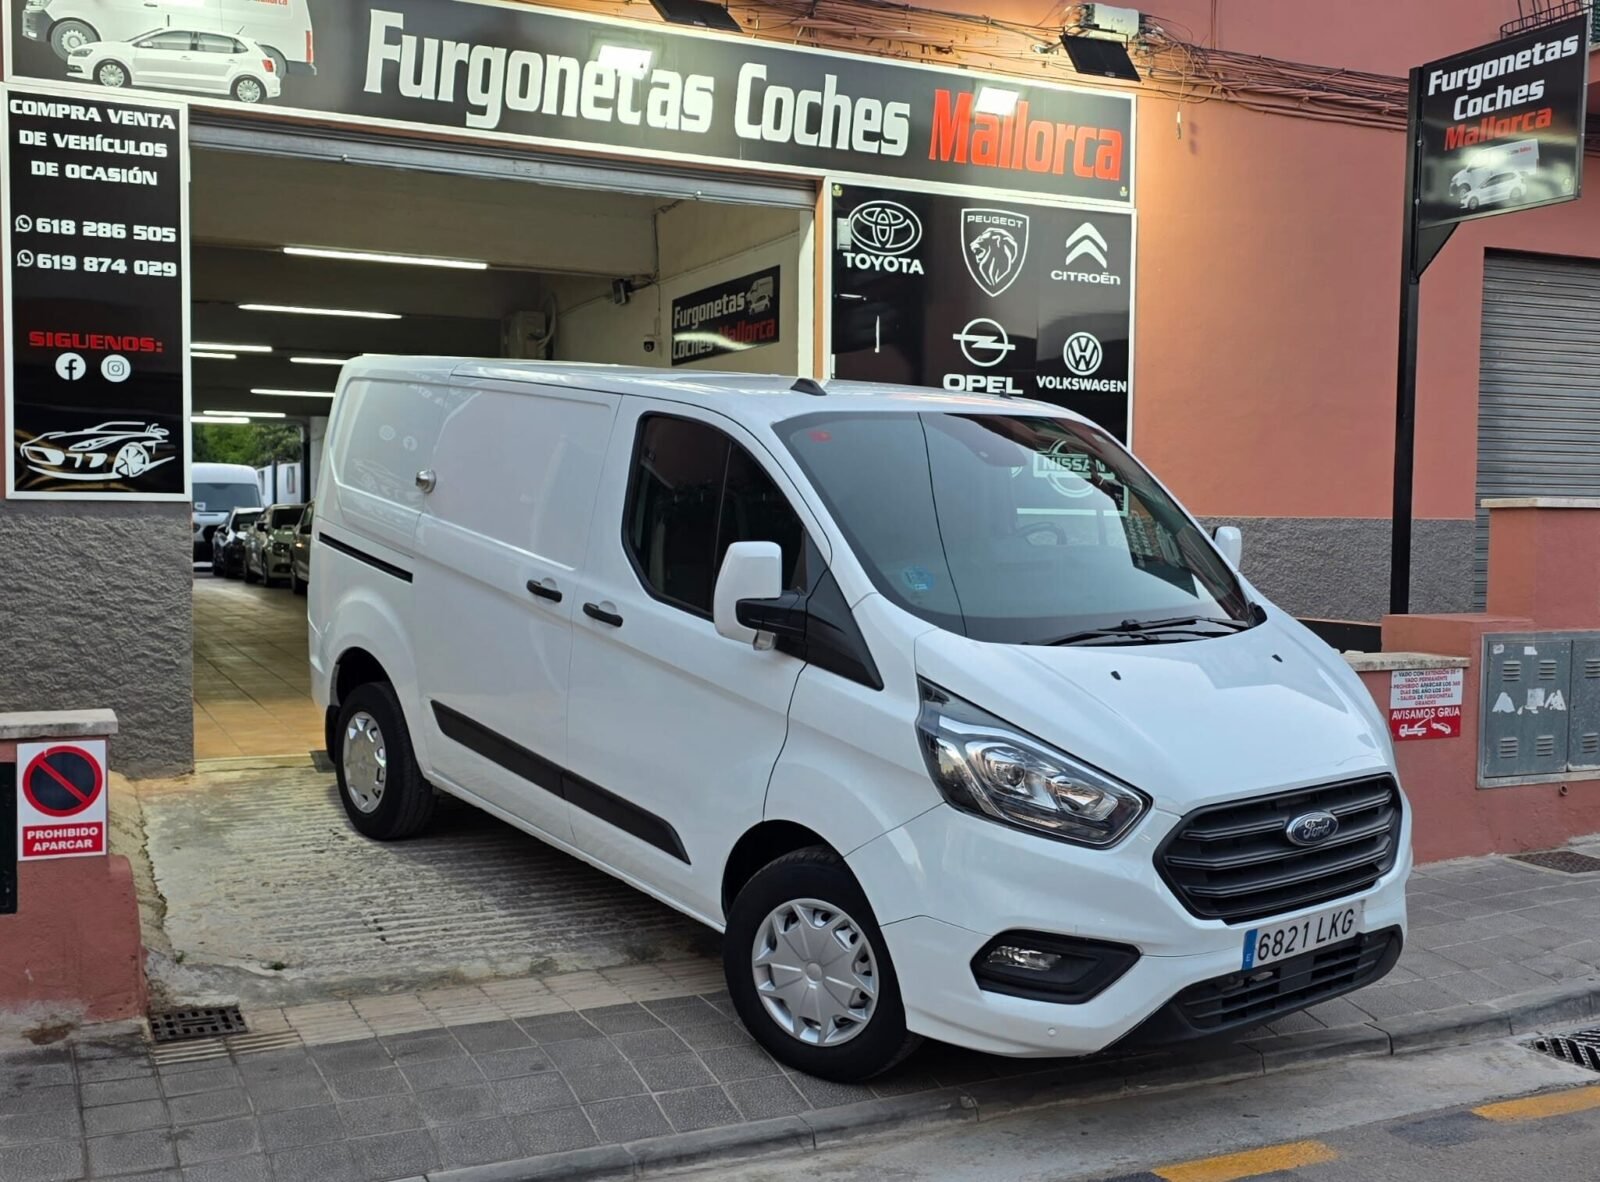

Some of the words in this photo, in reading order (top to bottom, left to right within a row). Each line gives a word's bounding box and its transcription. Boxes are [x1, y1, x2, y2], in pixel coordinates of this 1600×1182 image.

[1428, 34, 1579, 96] Furgonetas
[364, 9, 714, 133] Furgonetas
[734, 62, 911, 157] Coches
[929, 88, 1122, 181] Mallorca
[1453, 79, 1545, 121] Coches
[9, 99, 101, 123] COMPRA
[107, 108, 176, 130] VENTA
[1444, 107, 1553, 151] Mallorca
[19, 129, 47, 147] DE
[53, 133, 168, 158] VEHÍCULOS
[31, 160, 59, 177] DE
[65, 164, 158, 186] OCASIÓN
[36, 217, 76, 235] 618
[83, 220, 126, 239] 286
[133, 224, 176, 243] 505
[967, 214, 1024, 229] PEUGEOT
[37, 253, 77, 271] 619
[84, 256, 127, 274] 874
[134, 259, 177, 277] 029
[842, 252, 924, 275] TOYOTA
[1050, 269, 1121, 285] CITROËN
[674, 292, 745, 329] Furgonetas
[29, 330, 163, 353] SIGUENOS:
[943, 373, 1024, 395] OPEL
[1036, 375, 1127, 393] VOLKSWAGEN
[1392, 708, 1435, 720] AVISAMOS
[1437, 707, 1460, 718] GRUA
[27, 827, 98, 840] PROHIBIDO
[1303, 817, 1331, 839] Ford
[33, 838, 93, 851] APARCAR
[1258, 921, 1310, 961] 6821
[1316, 908, 1355, 944] LKG
